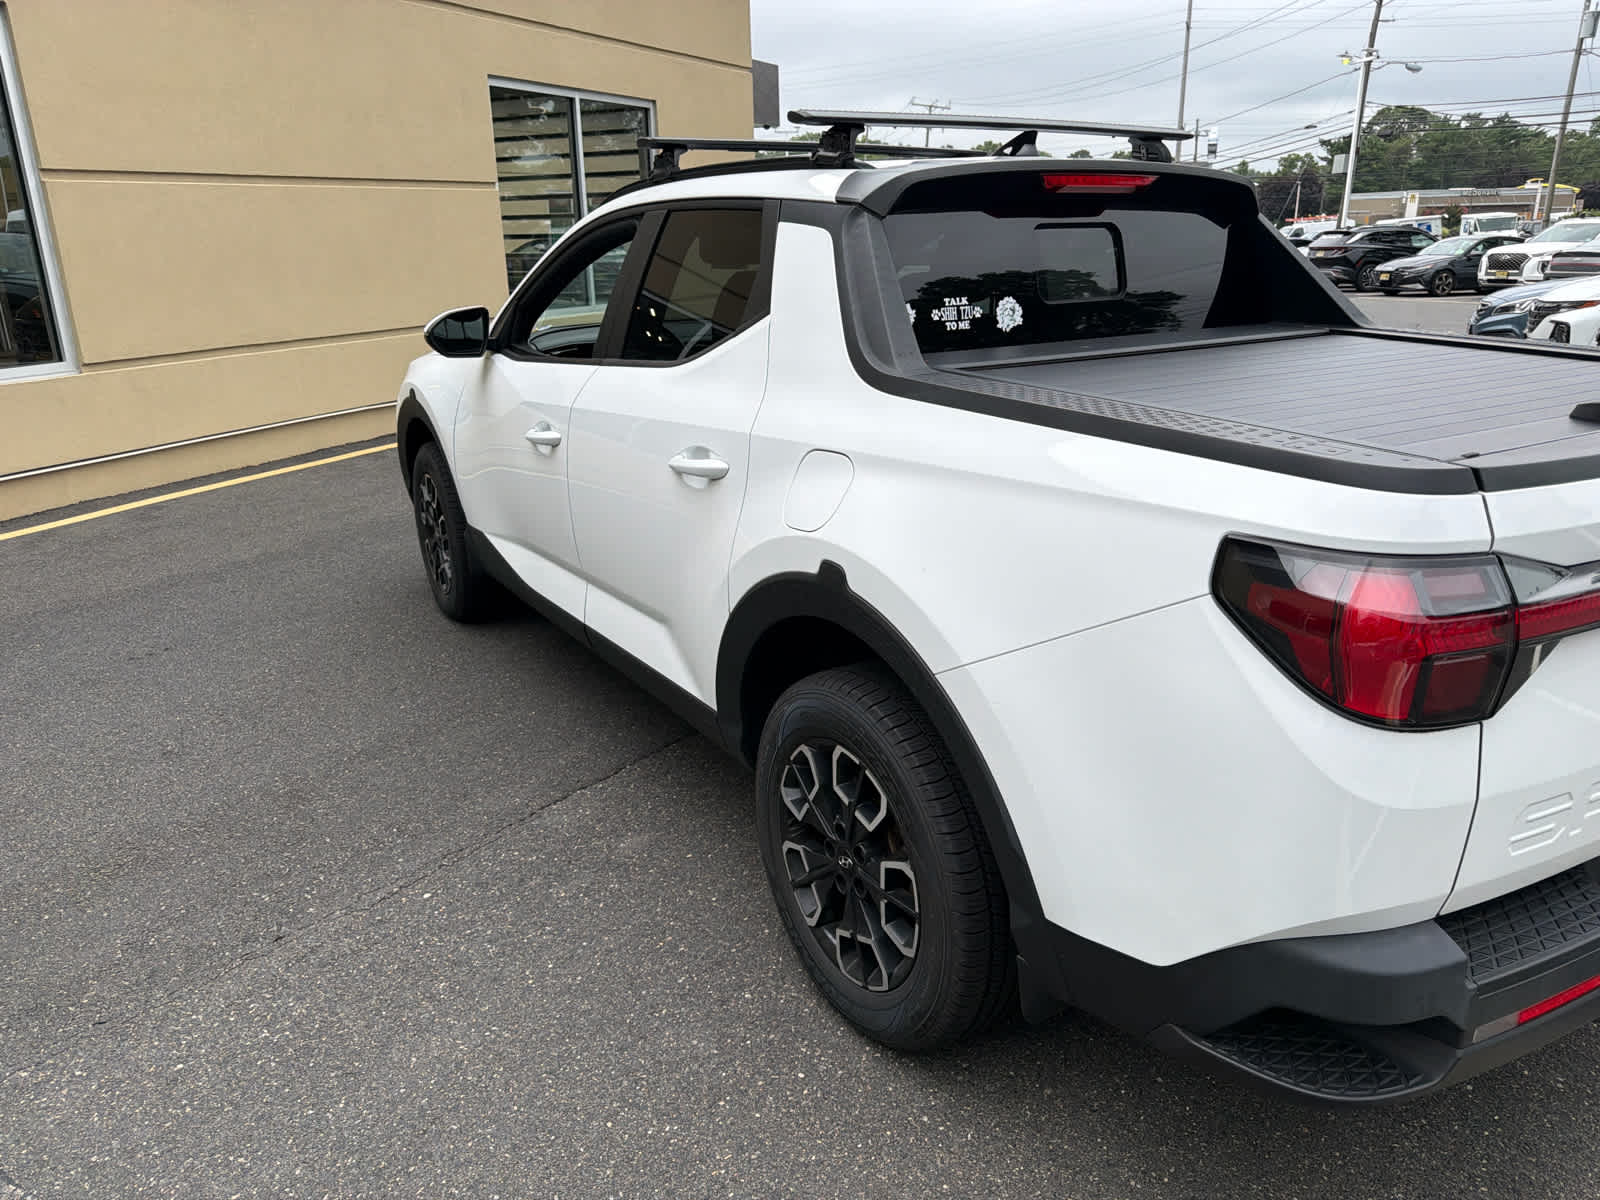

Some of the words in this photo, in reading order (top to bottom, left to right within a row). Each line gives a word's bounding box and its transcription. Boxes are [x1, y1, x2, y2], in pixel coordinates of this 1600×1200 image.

[943, 296, 969, 306] TALK
[940, 306, 958, 321] SHIH
[959, 305, 974, 320] TZU
[945, 321, 958, 331] TO
[958, 320, 971, 331] ME
